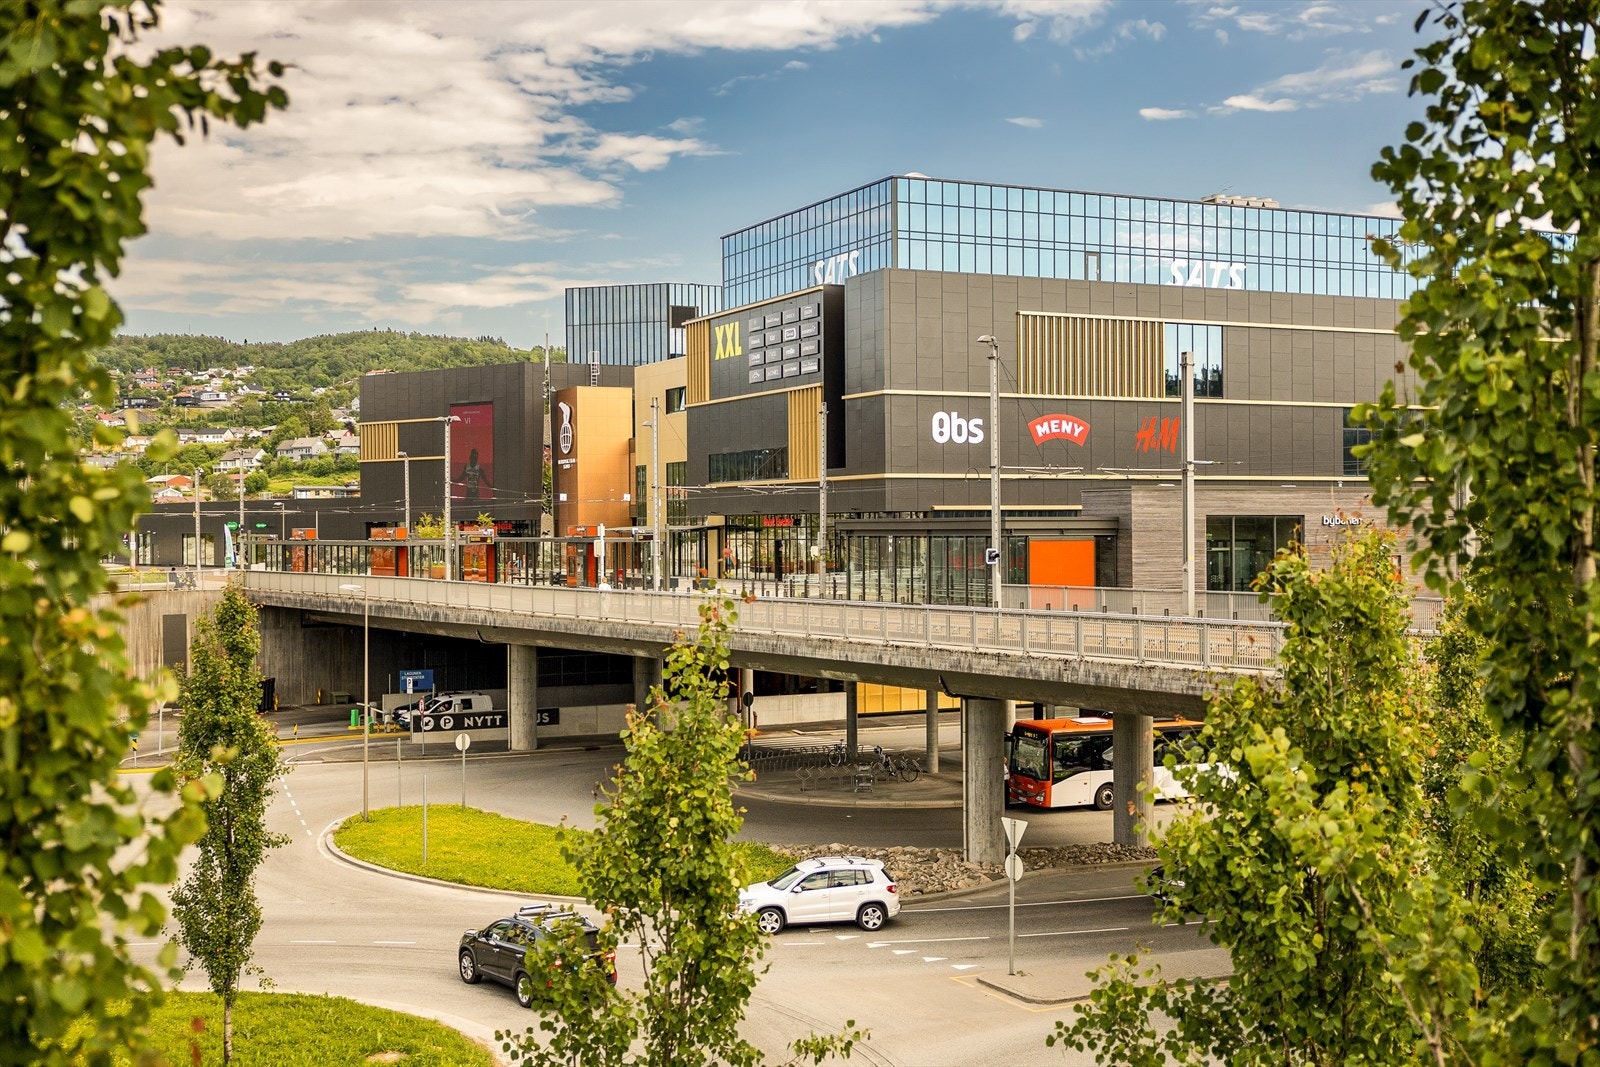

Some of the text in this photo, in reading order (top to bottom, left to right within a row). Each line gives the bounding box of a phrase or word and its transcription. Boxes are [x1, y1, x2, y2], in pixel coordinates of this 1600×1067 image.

[814, 250, 859, 285] SATS
[1165, 259, 1247, 290] SATS
[714, 321, 742, 361] XXL
[932, 411, 984, 444] Obs
[1035, 419, 1084, 438] MENY
[1135, 416, 1180, 454] H&M
[464, 715, 502, 728] NYTT
